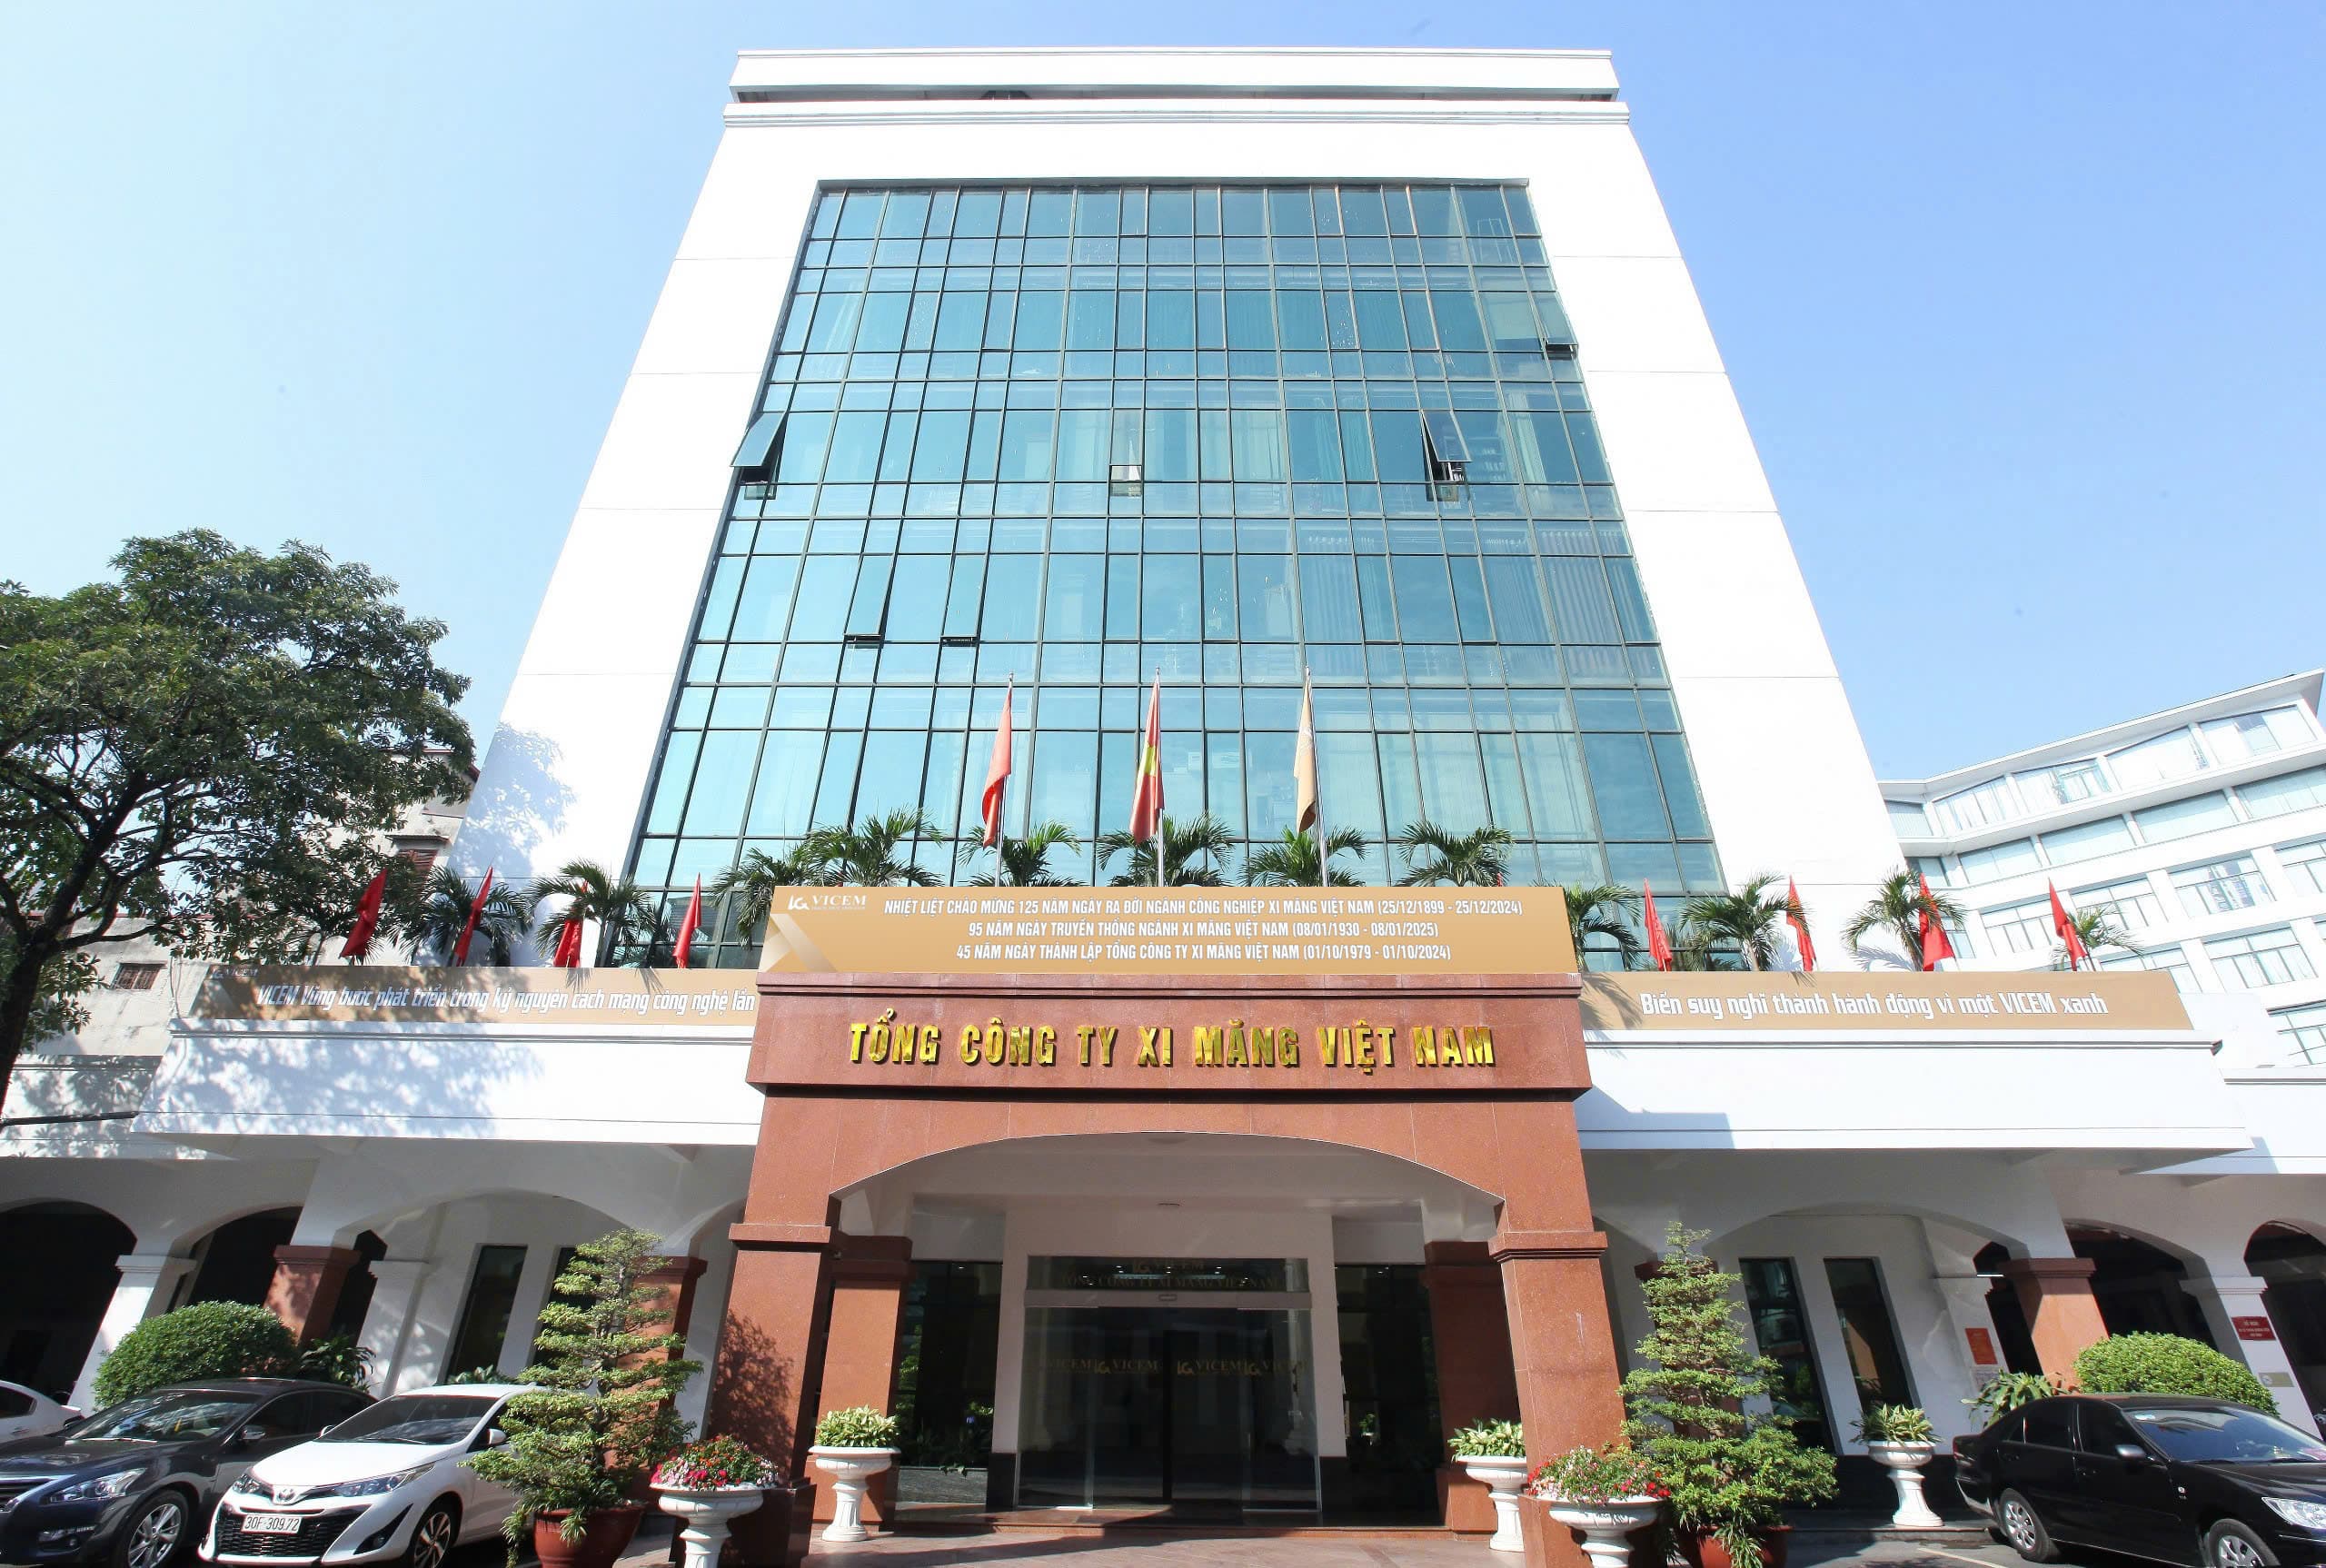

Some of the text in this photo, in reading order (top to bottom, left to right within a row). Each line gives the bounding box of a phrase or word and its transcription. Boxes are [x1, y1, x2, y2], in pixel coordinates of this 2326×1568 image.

[812, 895, 866, 906] VICEM
[884, 897, 918, 917] NHIỆT
[919, 897, 945, 917] LIỆT
[947, 897, 978, 914] CHÀO
[1018, 900, 1039, 914] 125
[1042, 898, 1069, 914] NĂM
[1071, 898, 1102, 914] NGÀY
[1106, 900, 1120, 914] RA
[1188, 897, 1220, 914] CÔNG
[1223, 897, 1265, 917] NGHIỆP
[1268, 900, 1280, 914] XI
[1283, 897, 1317, 914] MĂNG
[1320, 897, 1344, 917] VIỆT
[1347, 900, 1375, 914] NAM
[1377, 899, 1445, 915] (25/12/1899
[1456, 899, 1523, 915] 25/12/2024)
[969, 922, 983, 937] 95
[986, 919, 1013, 937] NĂM
[1016, 919, 1047, 937] NGÀY
[1098, 917, 1135, 937] THỐNG
[1182, 922, 1193, 937] XI
[1197, 919, 1231, 937] MĂNG
[1234, 918, 1258, 939] VIỆT
[1261, 922, 1288, 937] NAM
[1292, 922, 1359, 938] (08/01/1930
[1371, 922, 1438, 938] 08/01/2025)
[957, 945, 971, 959] 45
[974, 941, 1000, 959] NĂM
[1004, 941, 1037, 959] NGÀY
[1039, 941, 1078, 959] THÀNH
[1080, 941, 1102, 963] LẬP
[1139, 941, 1171, 959] CÔNG
[1174, 945, 1188, 959] TY
[1191, 945, 1203, 959] XI
[1207, 941, 1241, 959] MĂNG
[1245, 941, 1269, 962] VIỆT
[1272, 945, 1299, 959] NAM
[1303, 944, 1371, 959] (01/10/1979
[1382, 944, 1451, 959] 01/10/2024)
[255, 985, 301, 1005] VICEM
[373, 986, 410, 1010] phát
[411, 984, 446, 1007] triển
[450, 986, 490, 1011] trong
[515, 988, 569, 1015] nguyên
[571, 987, 605, 1010] cách
[608, 993, 649, 1014] mạng
[653, 989, 689, 1016] công
[691, 990, 729, 1016] nghệ
[1640, 989, 1682, 1015] Biến
[1686, 997, 1724, 1020] suy
[1772, 993, 1829, 1015] thành
[1832, 993, 1882, 1015] hành
[1884, 992, 1934, 1020] động
[1934, 992, 1955, 1014] vì
[1956, 993, 1999, 1018] một
[1998, 992, 2058, 1014] VICEM
[2059, 992, 2109, 1014] xanh
[850, 1007, 1496, 1076] TỔNG CÔNG TY XI MĂNG VIỆT NAM
